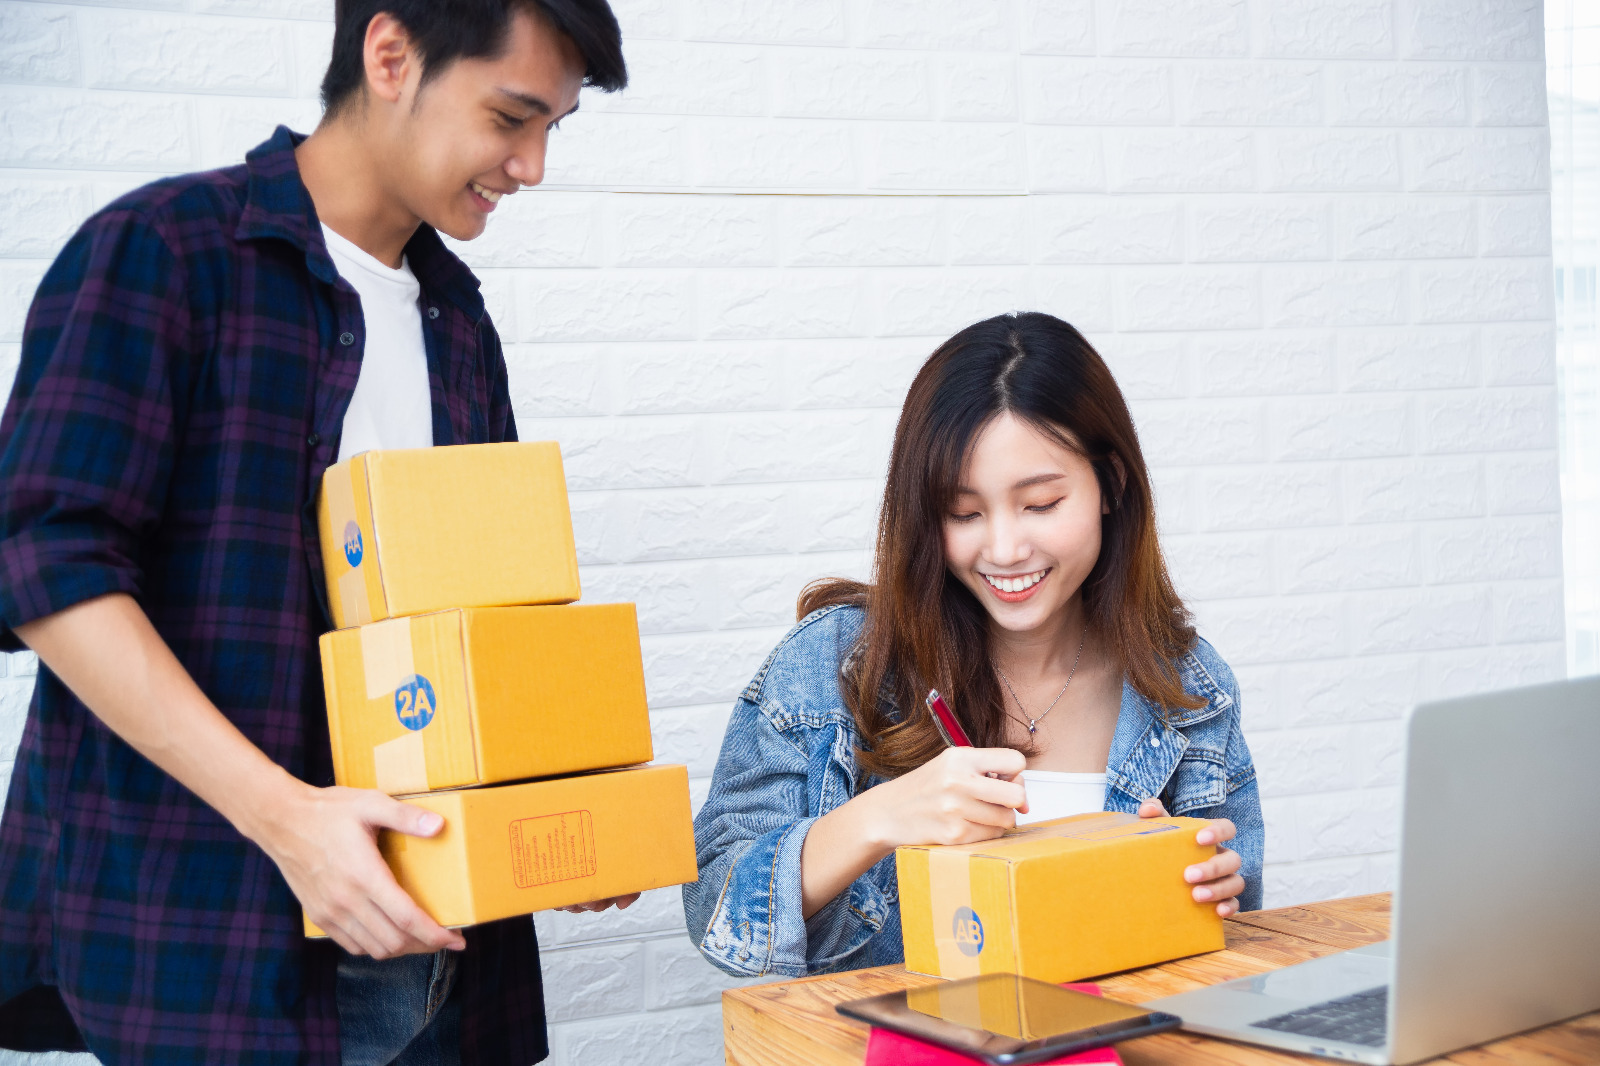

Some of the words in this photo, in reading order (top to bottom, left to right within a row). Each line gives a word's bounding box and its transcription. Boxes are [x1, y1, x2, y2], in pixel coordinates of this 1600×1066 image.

[347, 534, 362, 554] AA
[398, 687, 433, 718] 2A
[956, 918, 982, 944] AB
